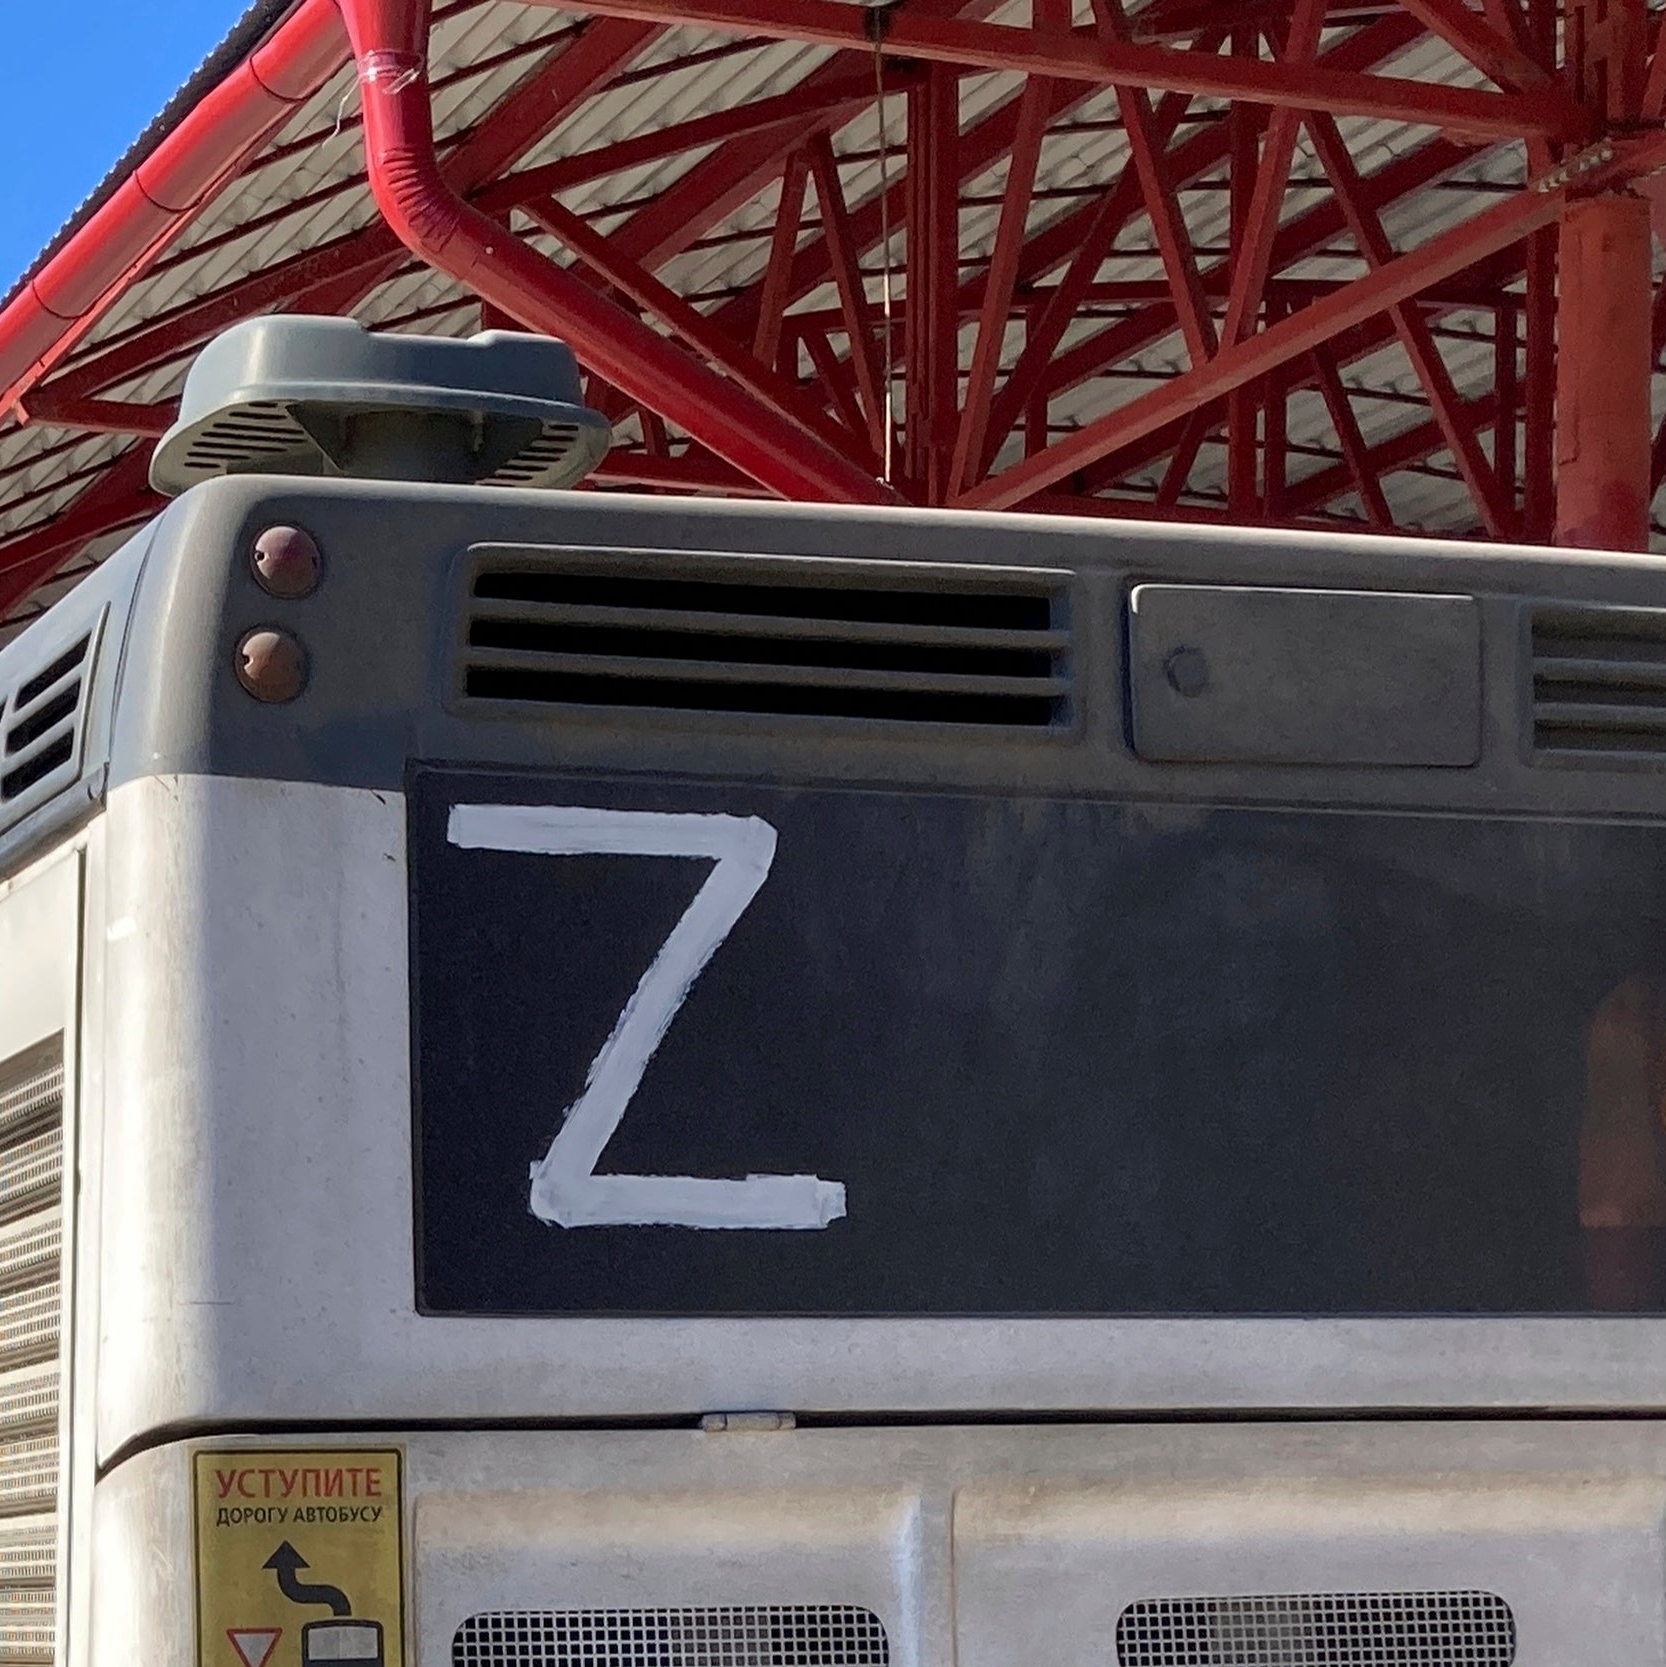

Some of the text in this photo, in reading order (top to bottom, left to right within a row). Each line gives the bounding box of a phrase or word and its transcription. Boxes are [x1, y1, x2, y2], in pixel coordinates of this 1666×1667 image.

[445, 803, 848, 1229] Z
[215, 1467, 383, 1499] УСТУПИТЕ
[216, 1505, 383, 1528] ДОРОГУ АВТОБУСУ
